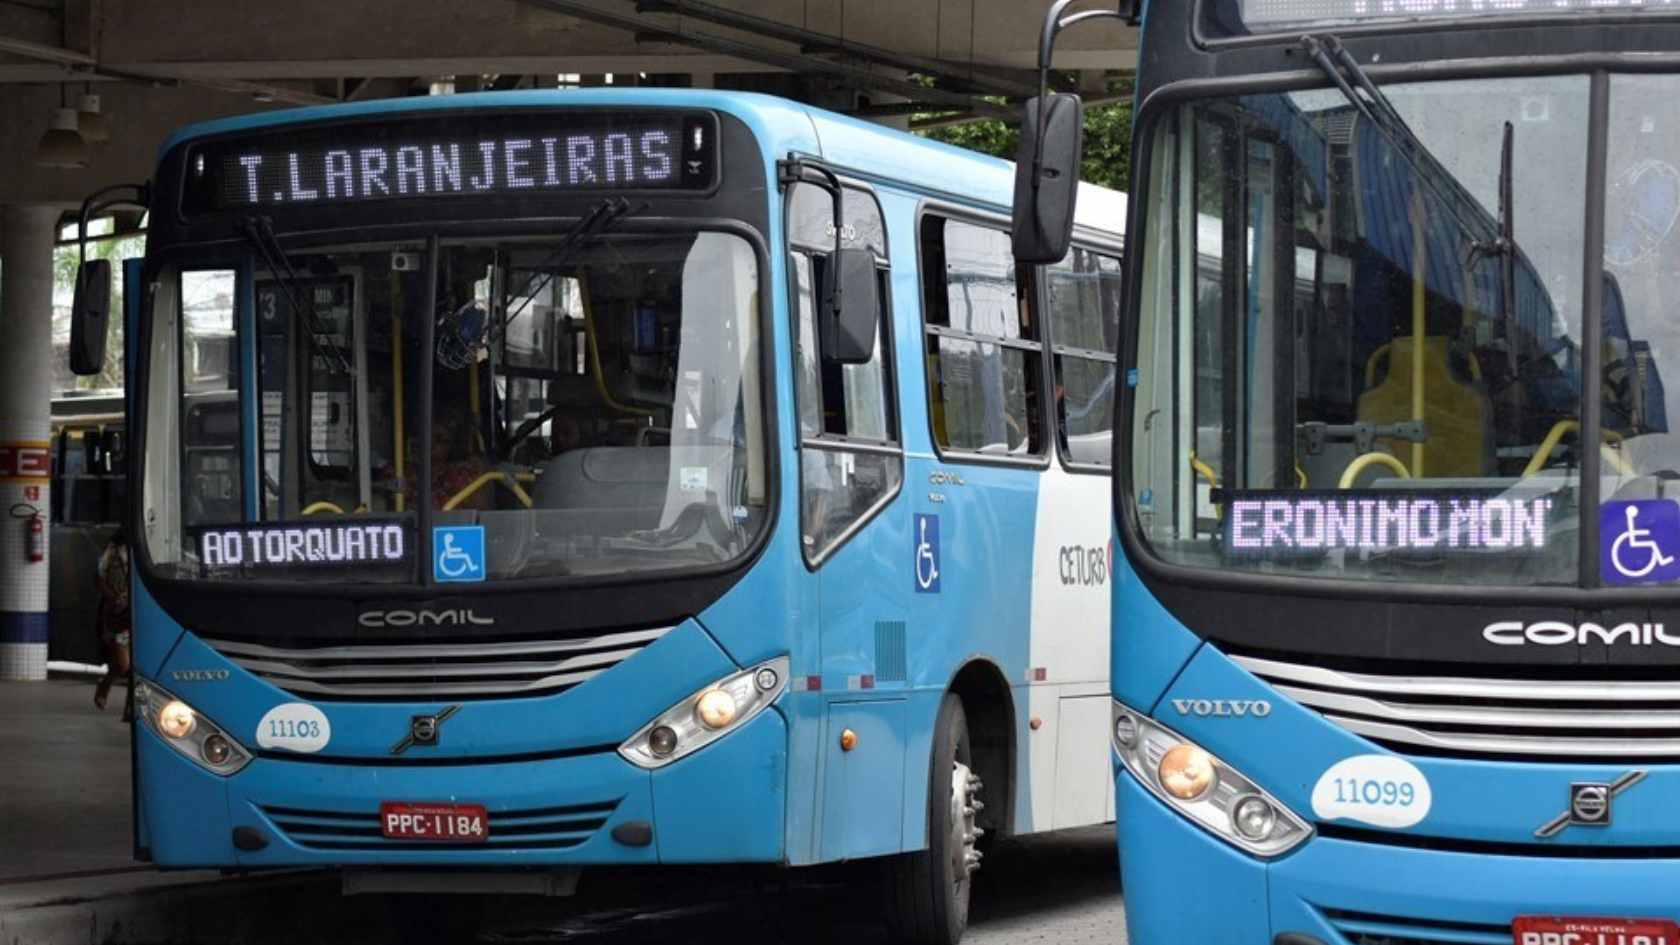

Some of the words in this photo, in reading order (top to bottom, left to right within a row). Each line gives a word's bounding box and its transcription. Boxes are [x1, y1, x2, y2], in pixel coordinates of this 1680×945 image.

[239, 130, 672, 203] T.LARANJEIRAS
[1232, 499, 1439, 547] ERONIMO
[1448, 498, 1553, 548] MON
[203, 531, 243, 565] AO
[248, 526, 403, 562] TORQUATO
[1060, 546, 1106, 587] CETURB
[358, 610, 494, 627] COMIL
[1482, 621, 1680, 646] COMIL
[171, 668, 230, 681] VOLVO
[1172, 698, 1272, 718] VOLVO
[269, 719, 321, 739] 11103
[1334, 777, 1415, 807] 11099
